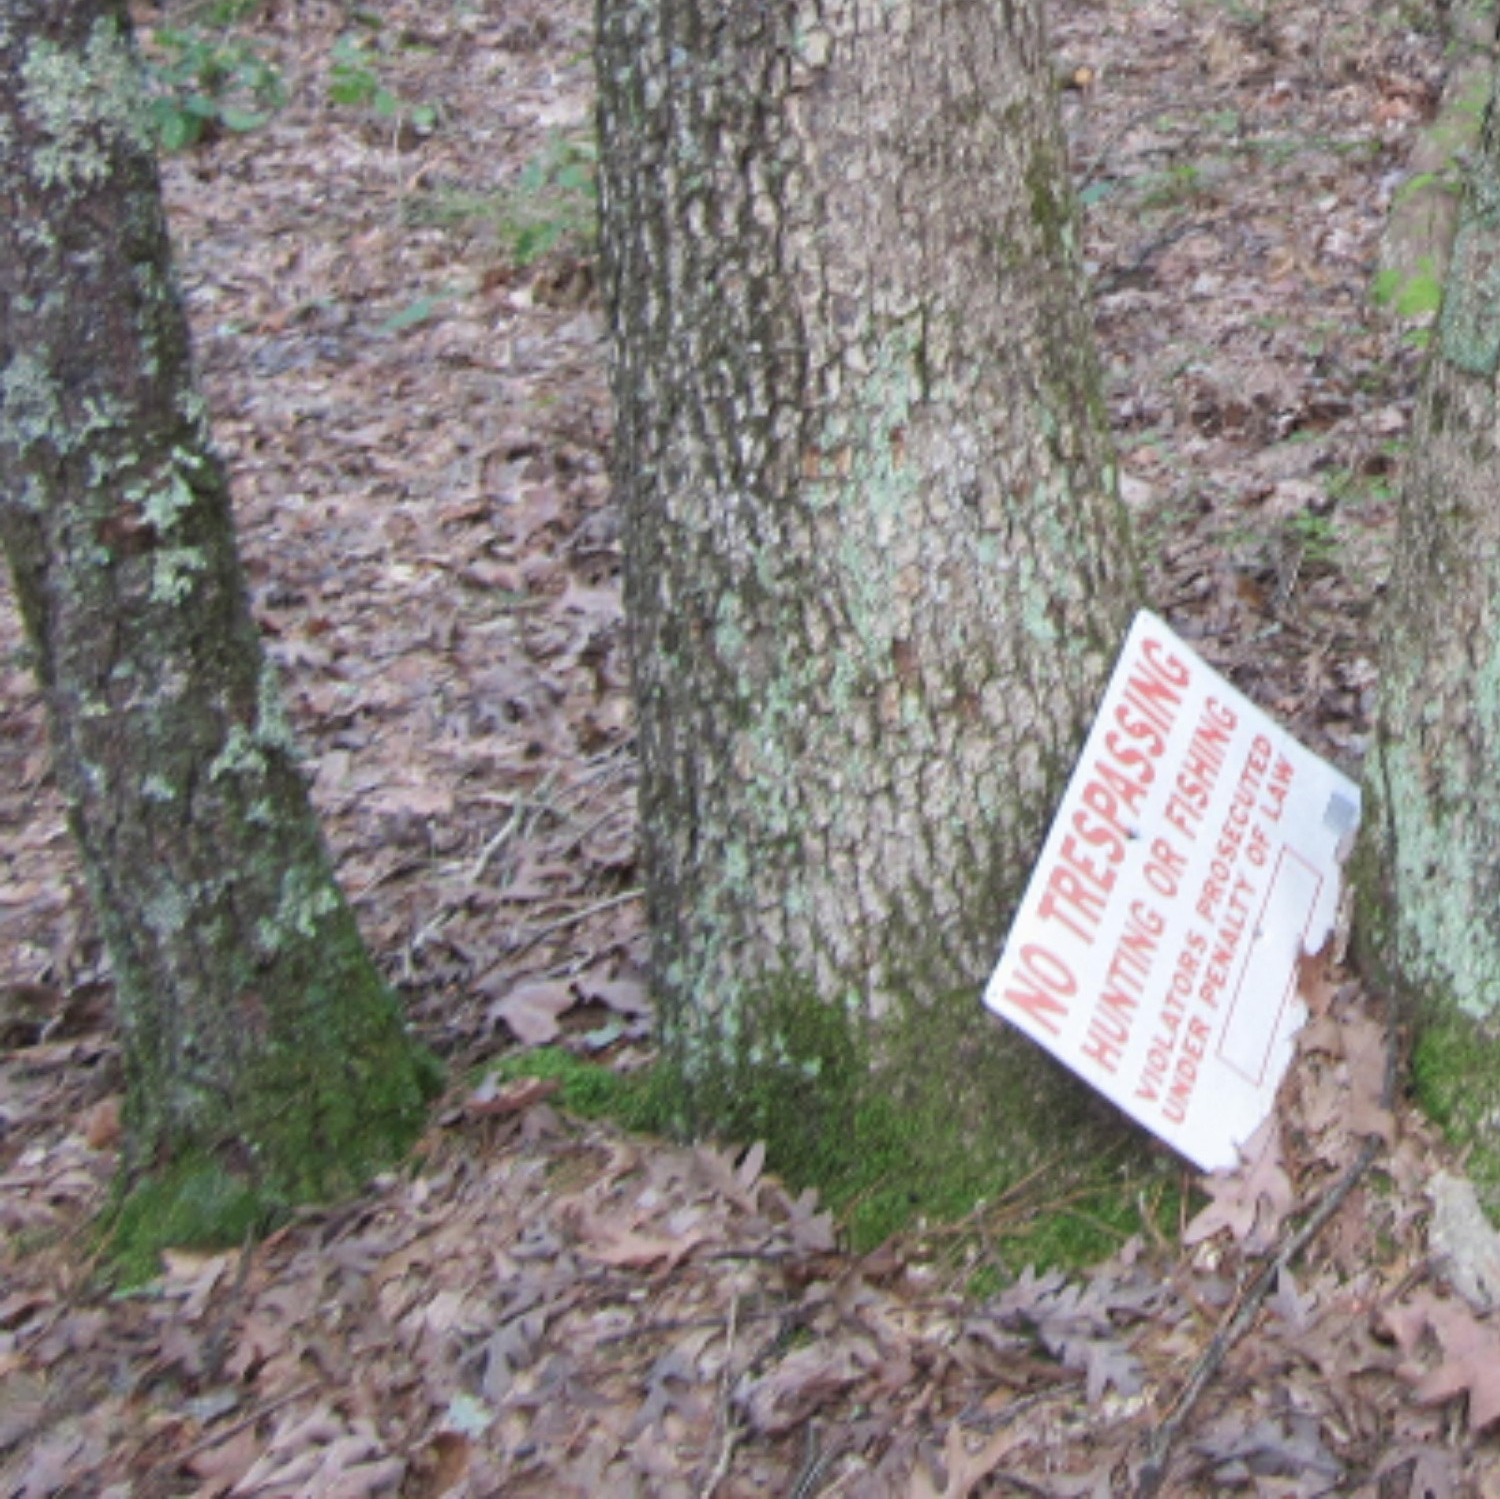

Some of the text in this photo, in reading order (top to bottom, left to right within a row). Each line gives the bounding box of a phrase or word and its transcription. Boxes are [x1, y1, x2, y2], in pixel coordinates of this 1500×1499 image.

[1002, 638, 1191, 1038] NO TRESPASSING
[1082, 696, 1239, 1075] HUNTING OR FISHING
[1136, 734, 1273, 1103] VIOLATORS PROSECUTED
[1162, 757, 1295, 1125] UNDER PENALTY OF LAW
